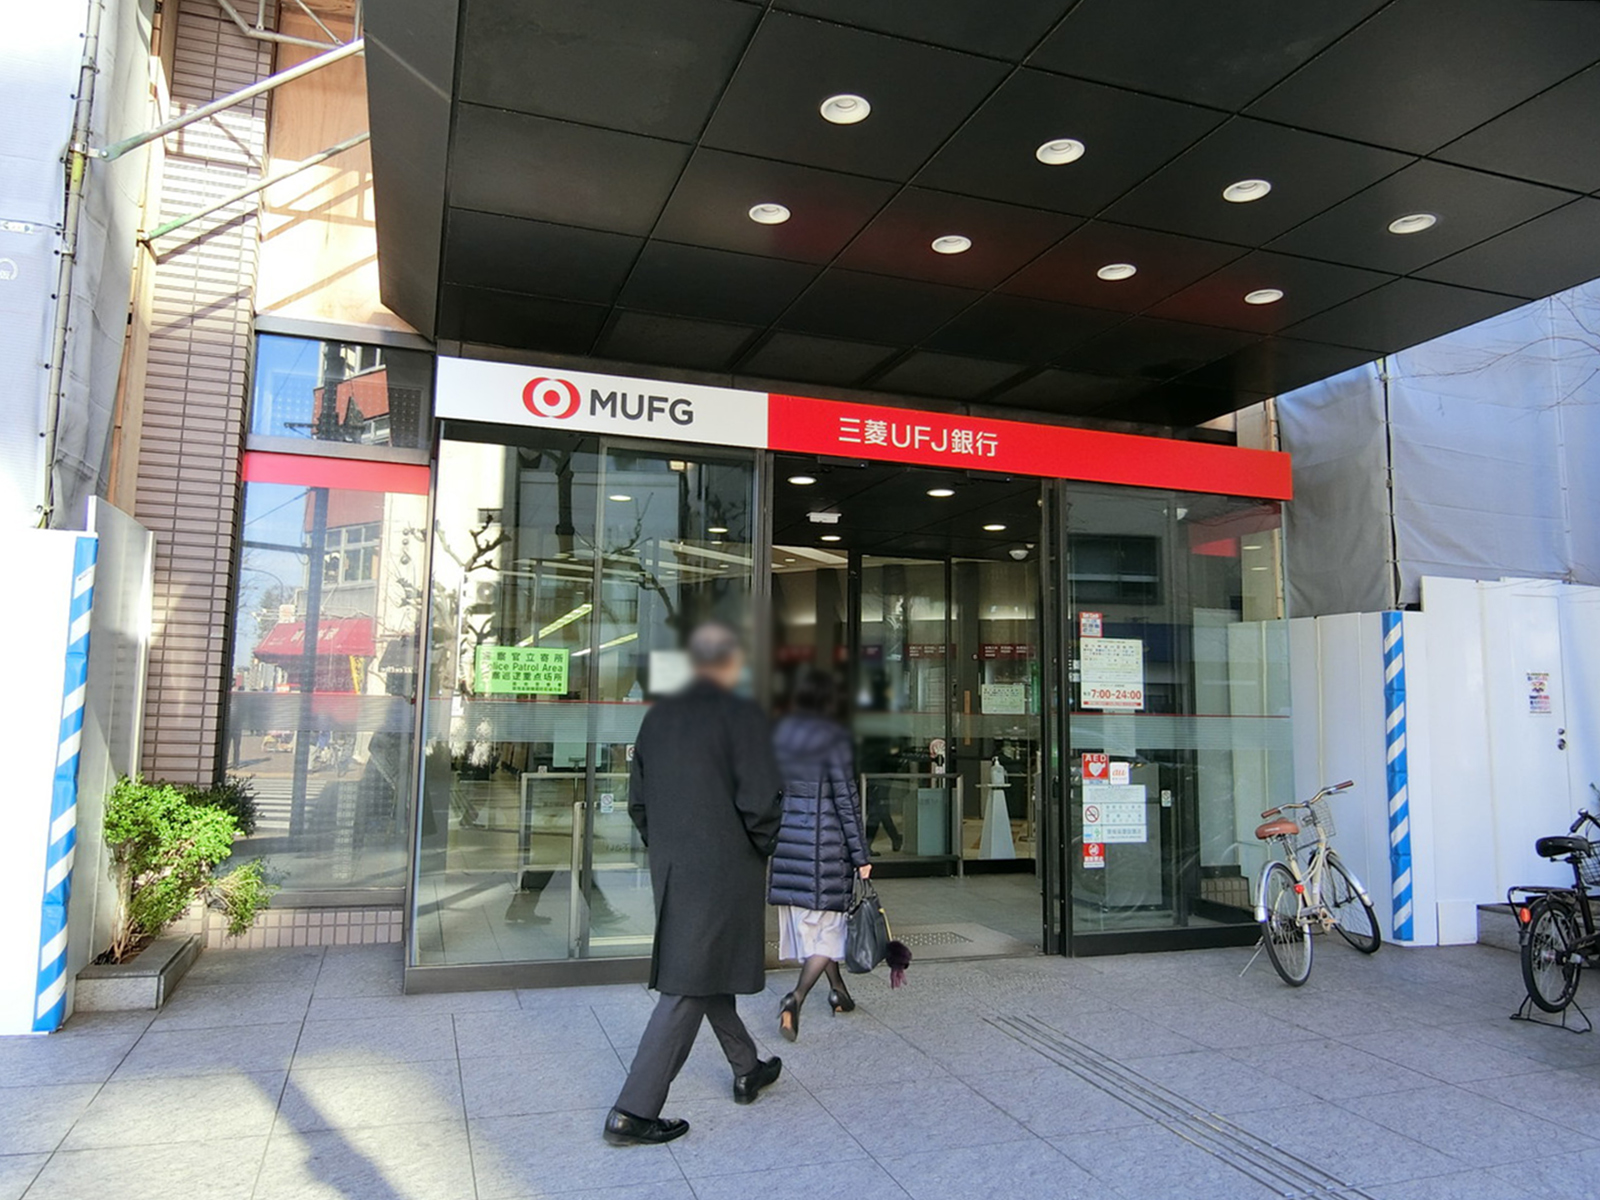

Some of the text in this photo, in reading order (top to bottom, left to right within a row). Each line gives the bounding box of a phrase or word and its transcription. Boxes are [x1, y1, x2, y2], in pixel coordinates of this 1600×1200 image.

[589, 389, 694, 426] MUFG
[838, 417, 998, 457] 三菱UFJ銀行
[512, 662, 539, 672] Patrol
[542, 663, 563, 672] Area
[1091, 689, 1142, 700] 7:00-24:00
[1085, 753, 1107, 762] AED
